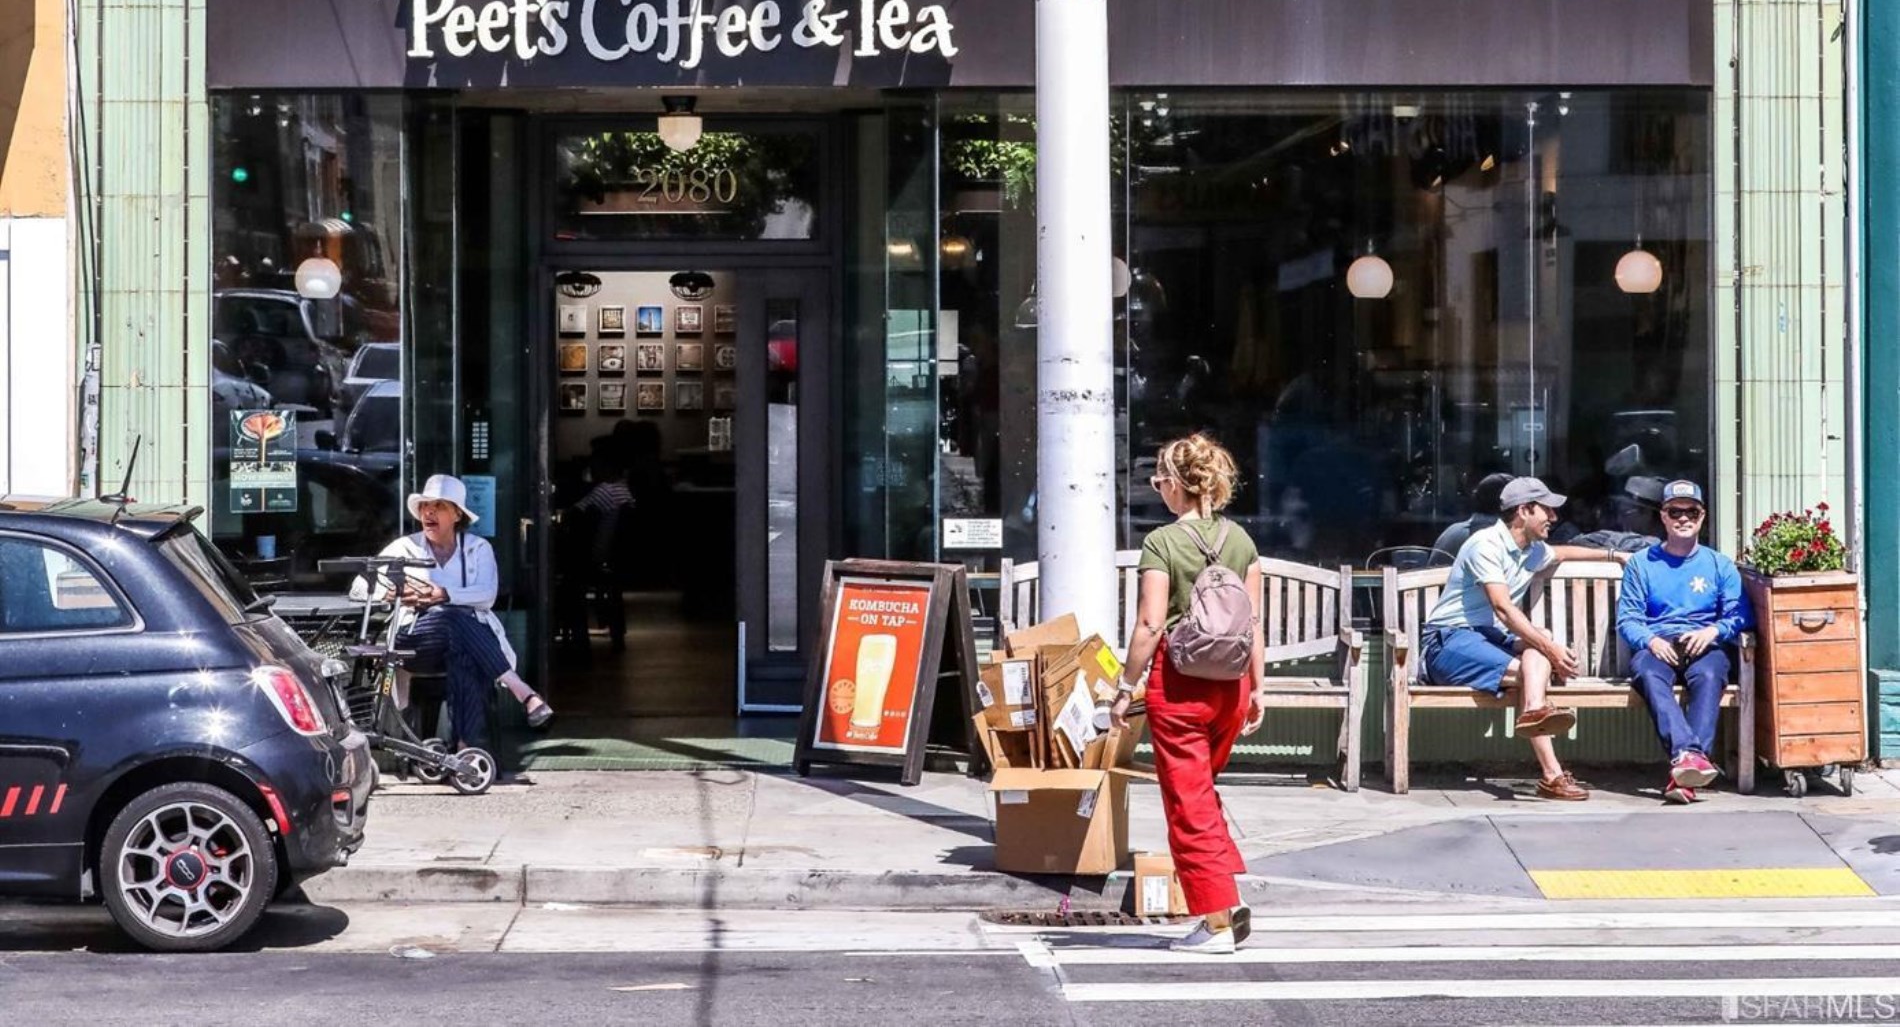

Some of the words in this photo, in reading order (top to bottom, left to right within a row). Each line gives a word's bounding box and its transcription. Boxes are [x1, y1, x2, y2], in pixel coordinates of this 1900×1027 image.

[637, 168, 737, 205] 2080
[848, 598, 919, 614] KOMBUCHA
[860, 613, 878, 625] ON
[882, 615, 905, 627] TAP
